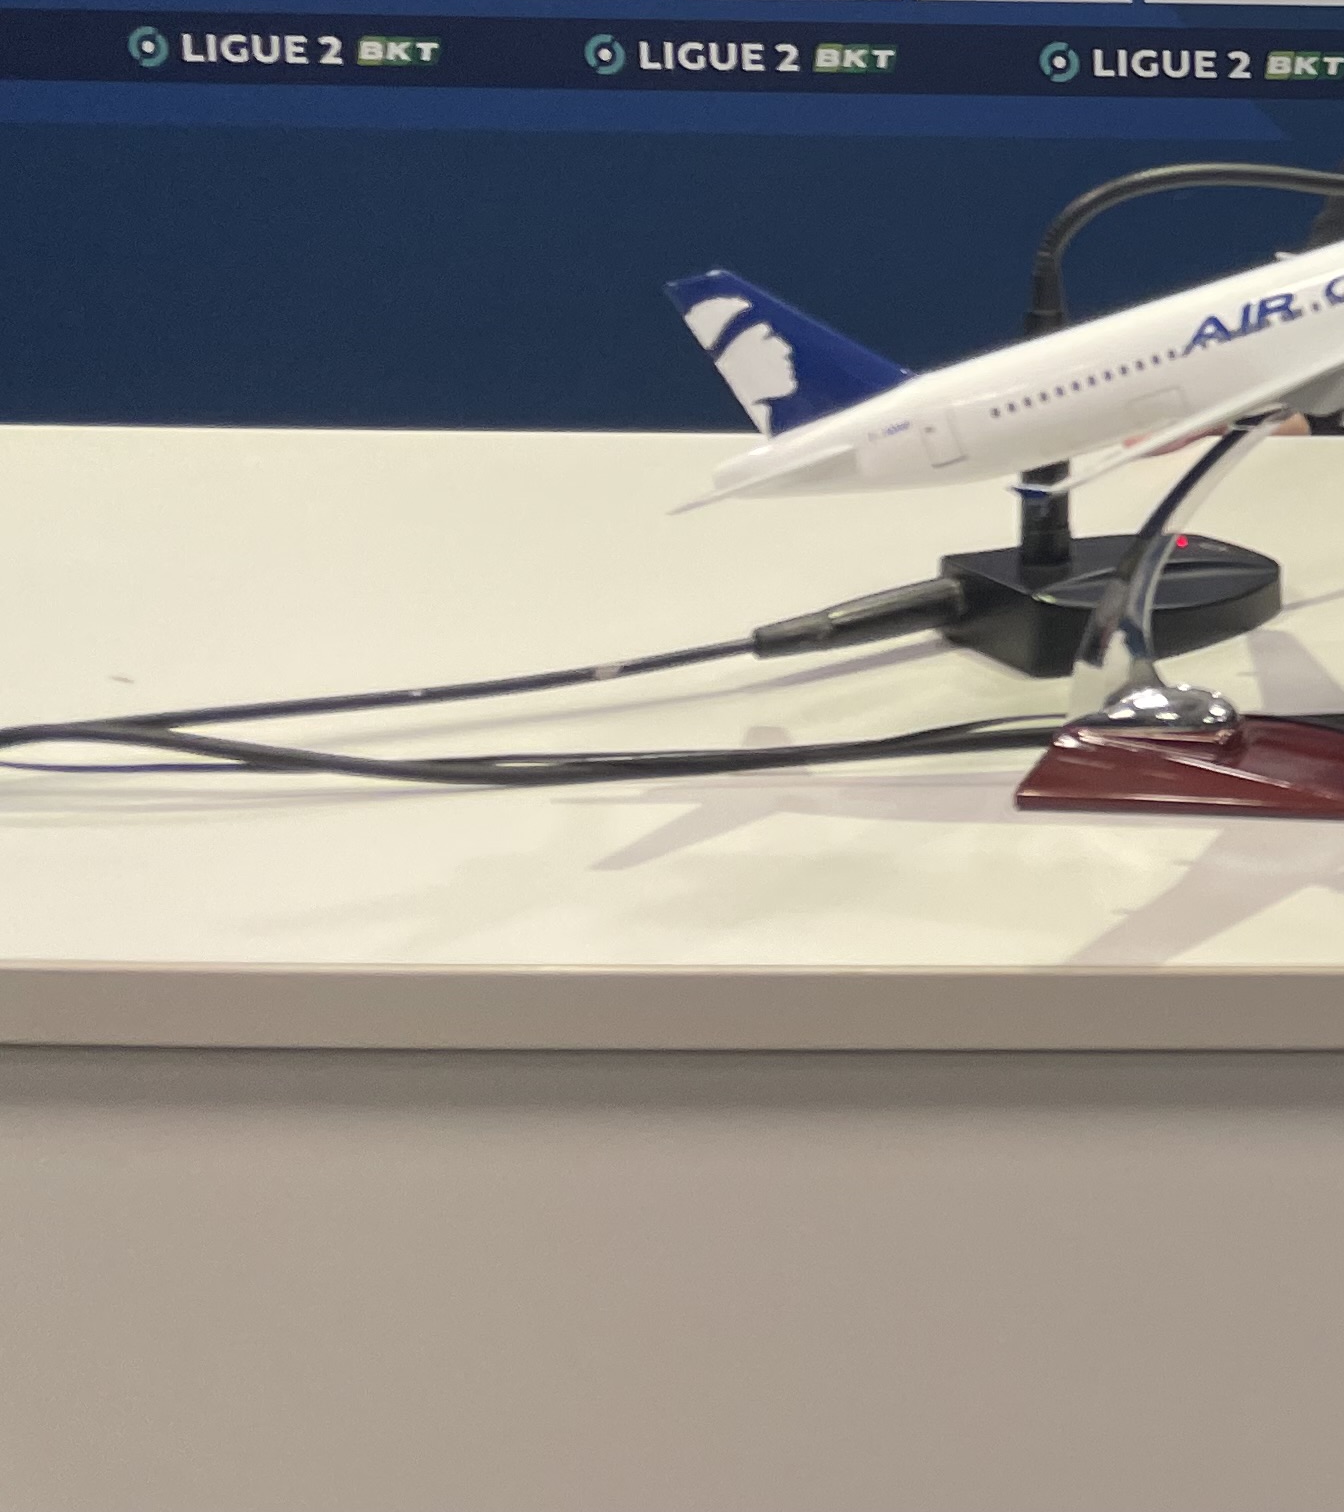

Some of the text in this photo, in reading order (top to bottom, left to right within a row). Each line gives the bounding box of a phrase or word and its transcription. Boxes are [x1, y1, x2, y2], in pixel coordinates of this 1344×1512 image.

[182, 33, 439, 65] LIGUE 2 BKT
[1093, 49, 1217, 79] LIGUE
[1227, 51, 1251, 80] 2
[1184, 293, 1302, 355] AIR
